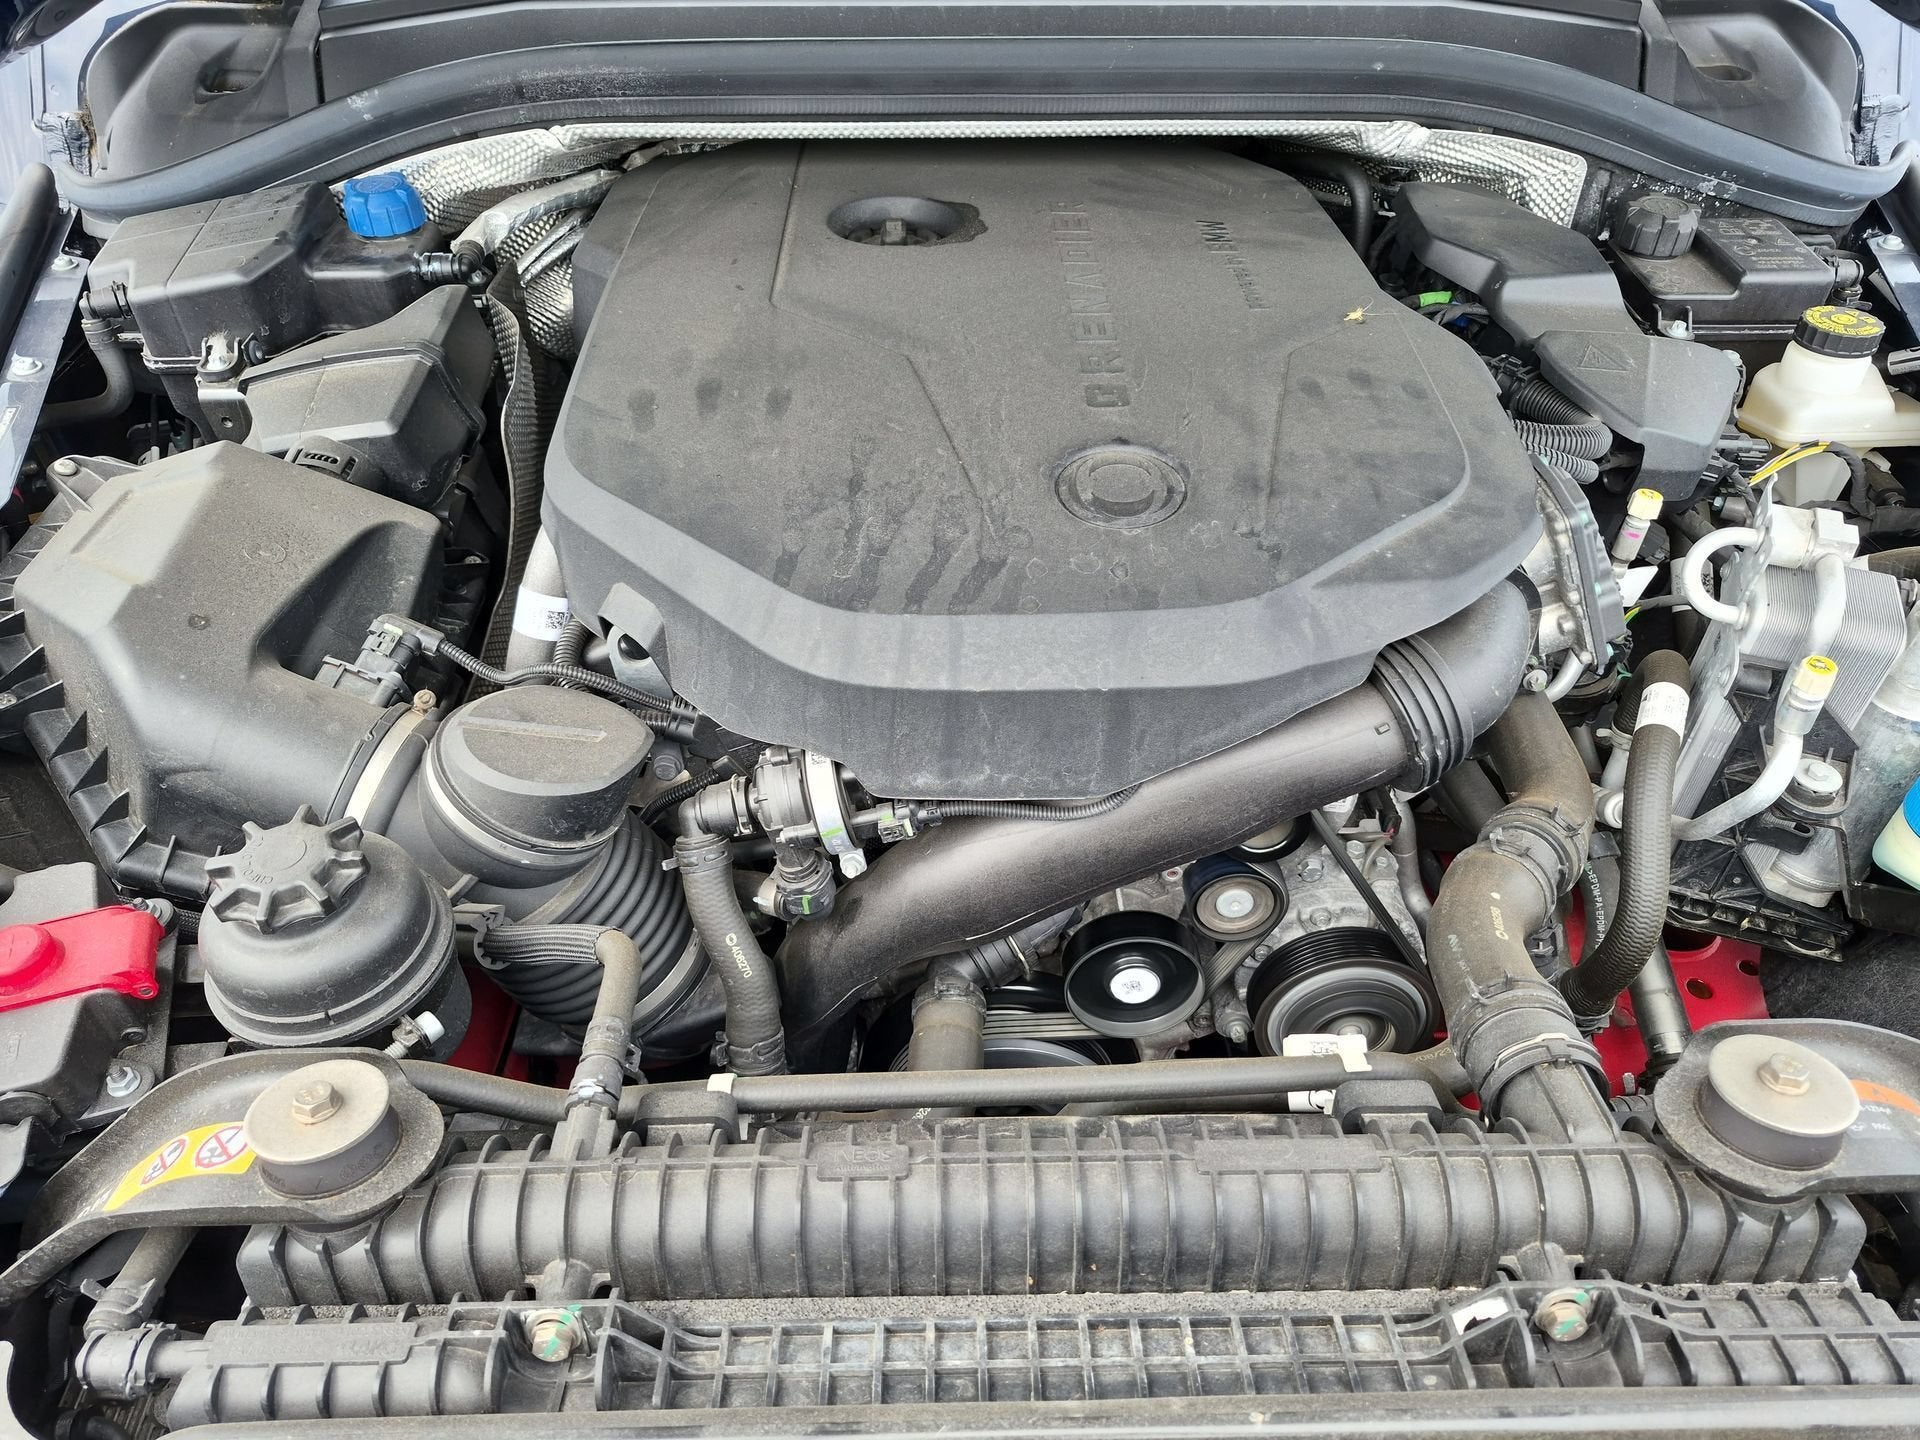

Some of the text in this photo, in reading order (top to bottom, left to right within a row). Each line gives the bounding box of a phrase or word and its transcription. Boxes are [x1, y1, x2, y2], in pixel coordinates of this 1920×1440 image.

[1195, 220, 1240, 254] BMW
[1048, 200, 1131, 408] GRENADIER
[731, 946, 753, 978] 406270
[832, 1148, 892, 1162] INEOS
